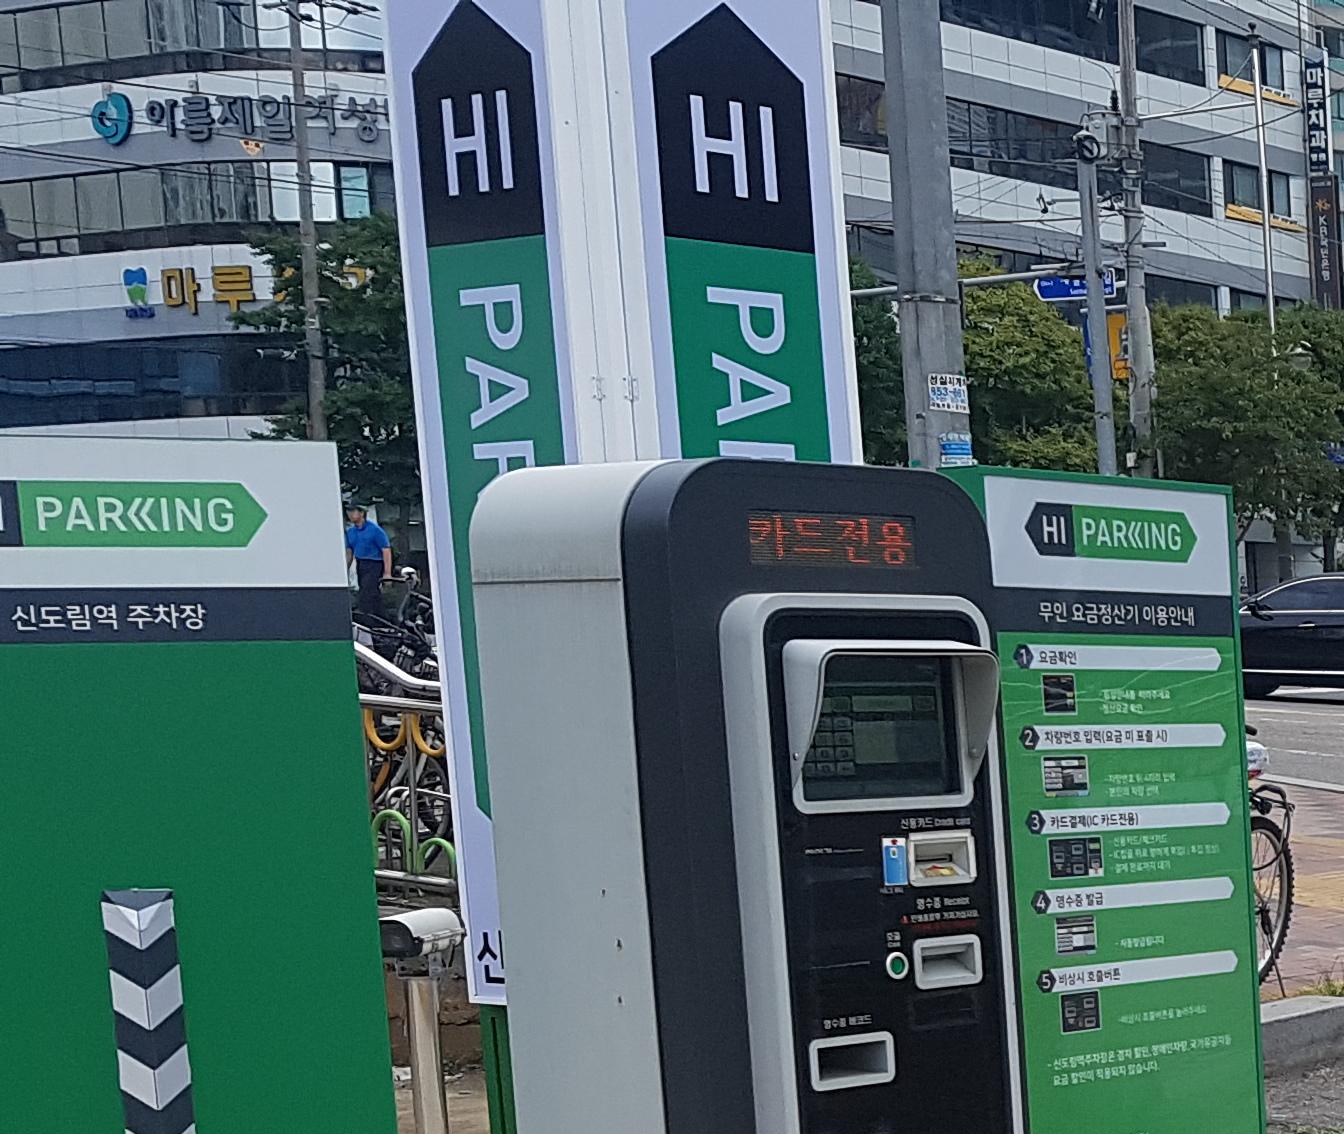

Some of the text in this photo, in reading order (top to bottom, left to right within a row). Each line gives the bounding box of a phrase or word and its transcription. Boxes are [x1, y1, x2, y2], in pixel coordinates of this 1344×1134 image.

[145, 95, 392, 143] 아름제일여성
[1306, 67, 1328, 150] 마루치과
[442, 90, 515, 197] HI
[690, 94, 779, 203] HI
[35, 496, 234, 532] PARKING
[748, 515, 913, 565] 카드전용
[1042, 515, 1183, 551] HI PARKING
[11, 603, 207, 631] 신도림역 주차장
[1039, 602, 1195, 627] 무인 요금정산기 이용안내
[1020, 649, 1077, 665] 1 요금확인
[1023, 730, 1034, 746] 2
[1044, 731, 1081, 744] 차량번호
[1031, 814, 1040, 829] 3
[1035, 894, 1046, 909] 4
[1056, 893, 1083, 907] 영수증
[1041, 968, 1121, 988] 5 비상시 호출버튼
